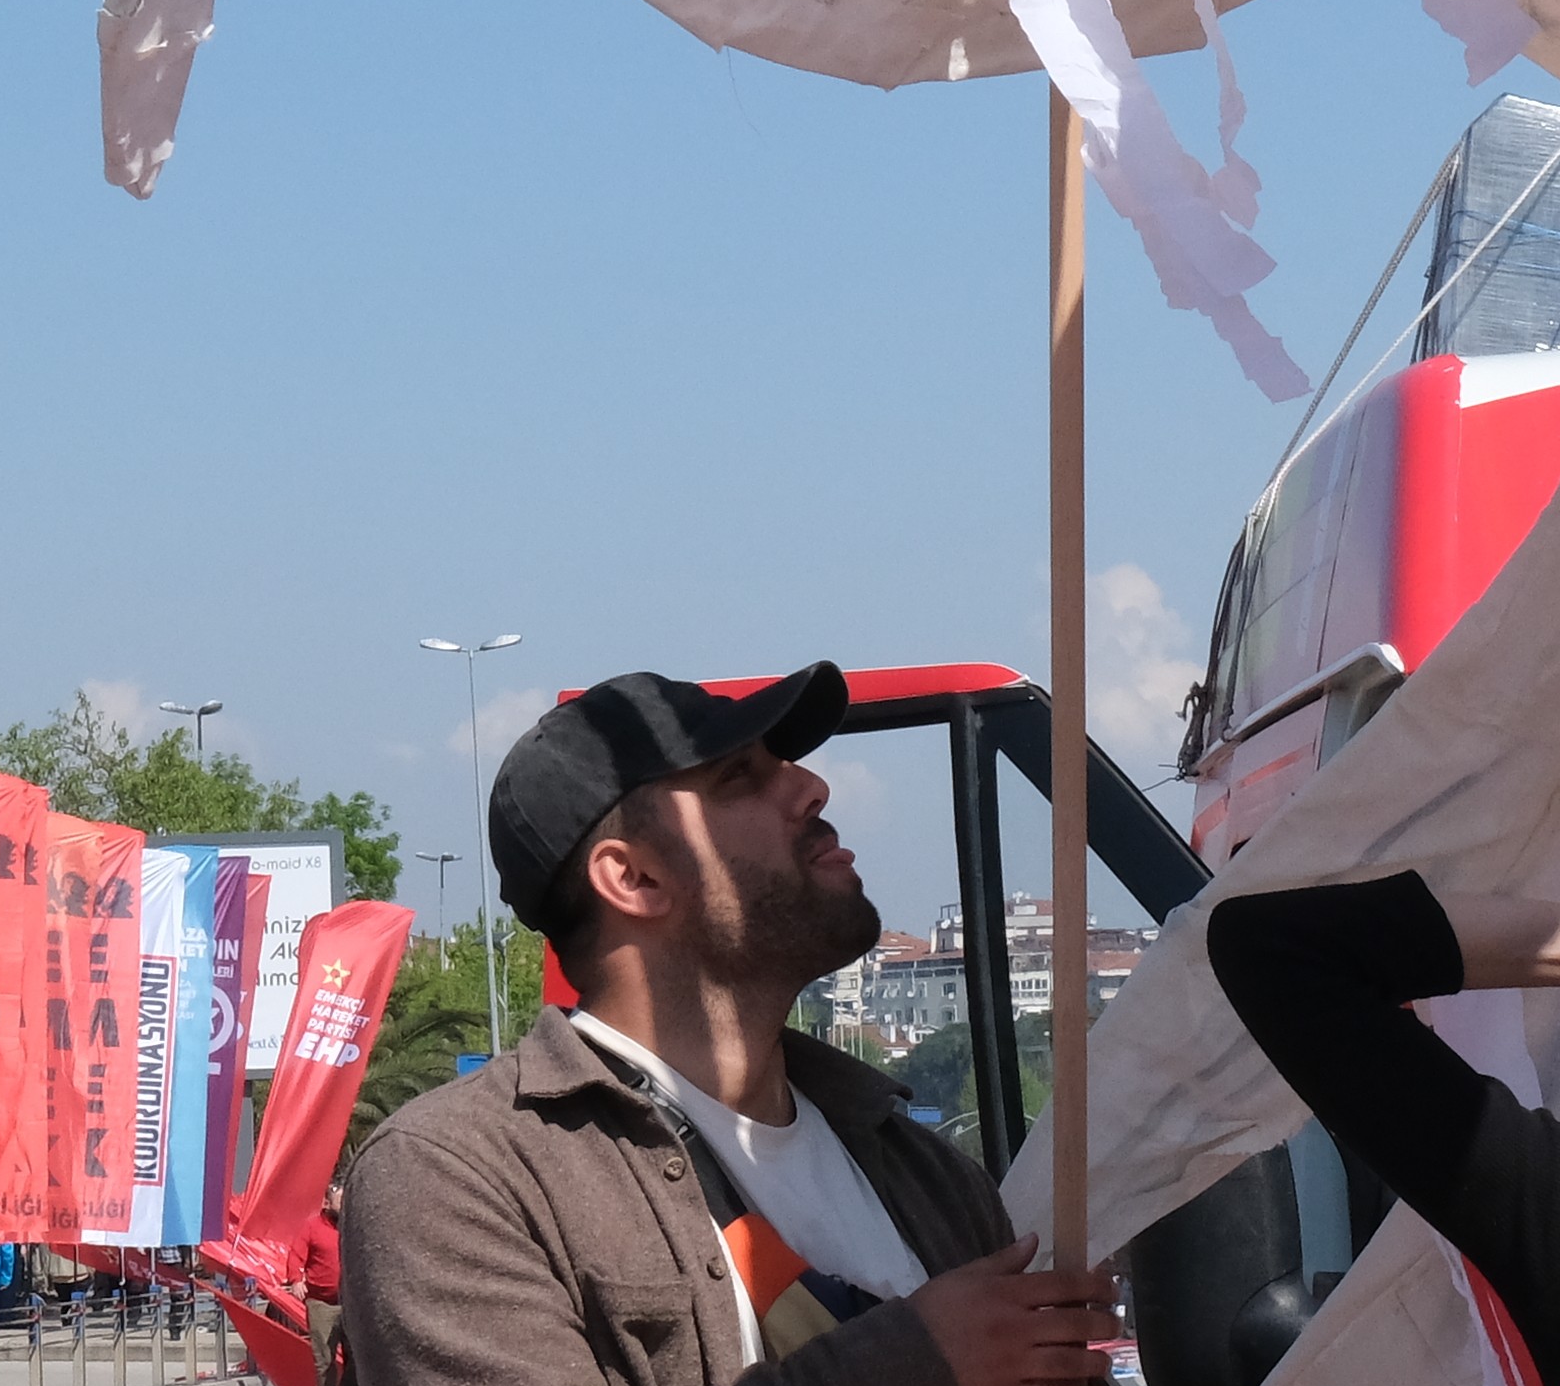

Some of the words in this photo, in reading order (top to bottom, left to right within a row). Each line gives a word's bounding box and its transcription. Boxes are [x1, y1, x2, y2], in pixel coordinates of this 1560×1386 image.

[314, 989, 365, 1011] EMEKÇİ
[311, 1003, 370, 1028] HAREKET
[307, 1017, 357, 1038] PARTİSİ
[294, 1033, 360, 1067] EHP
